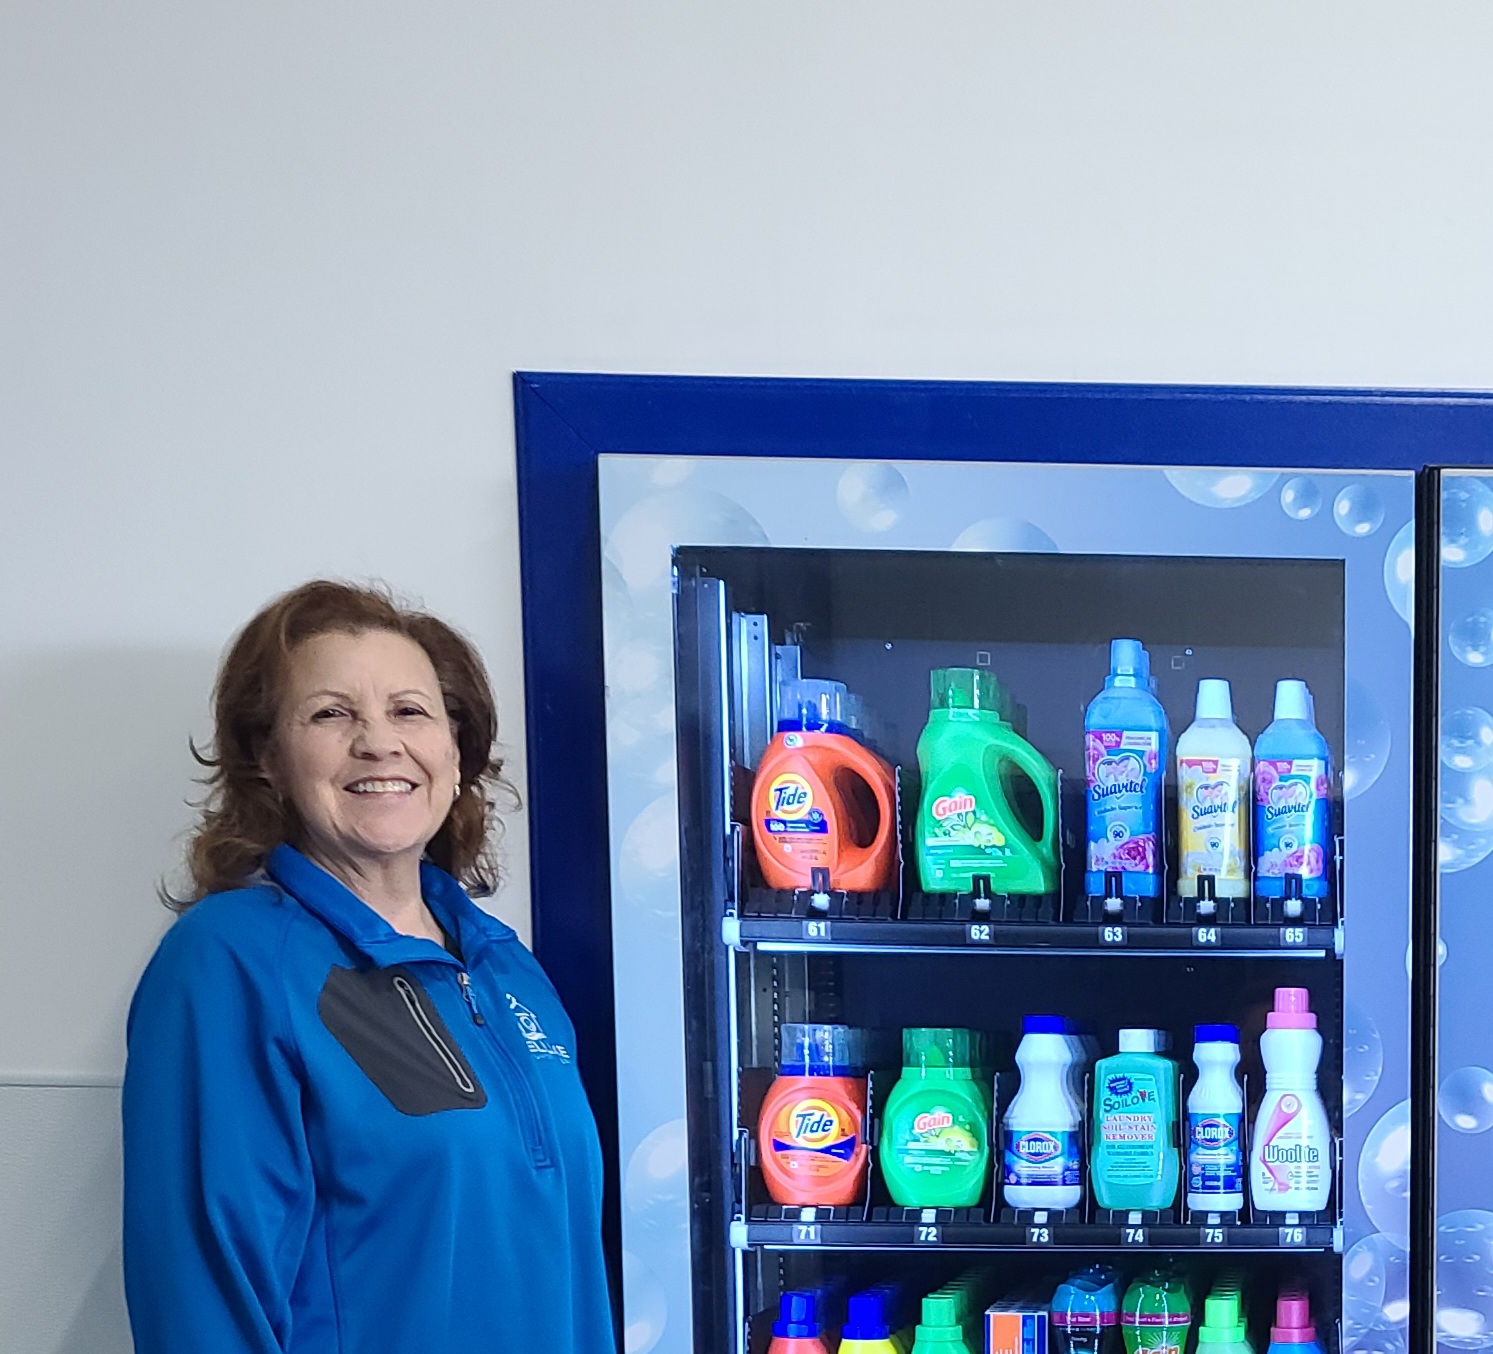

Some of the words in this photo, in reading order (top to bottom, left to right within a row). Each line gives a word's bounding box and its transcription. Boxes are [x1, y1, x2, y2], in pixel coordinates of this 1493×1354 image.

[1092, 779, 1146, 801] Suavitel
[773, 786, 808, 812] Tide
[934, 796, 974, 817] Gain
[1192, 800, 1237, 819] Suavitl
[807, 923, 826, 936] 61
[971, 925, 990, 939] 62
[1104, 928, 1122, 942] 63
[1198, 929, 1216, 942] 64
[1285, 929, 1304, 942] 65
[796, 1112, 834, 1138] Tide
[916, 1114, 951, 1131] Gain
[1196, 1126, 1230, 1140] CLOROX
[1020, 1140, 1055, 1153] CLOROX
[1264, 1144, 1318, 1163] Woolte
[798, 1228, 816, 1240] 71
[919, 1228, 937, 1241] 72
[1030, 1229, 1049, 1242] 73
[1126, 1229, 1144, 1242] 74
[1205, 1229, 1223, 1242] 75
[1284, 1229, 1302, 1242] 76
